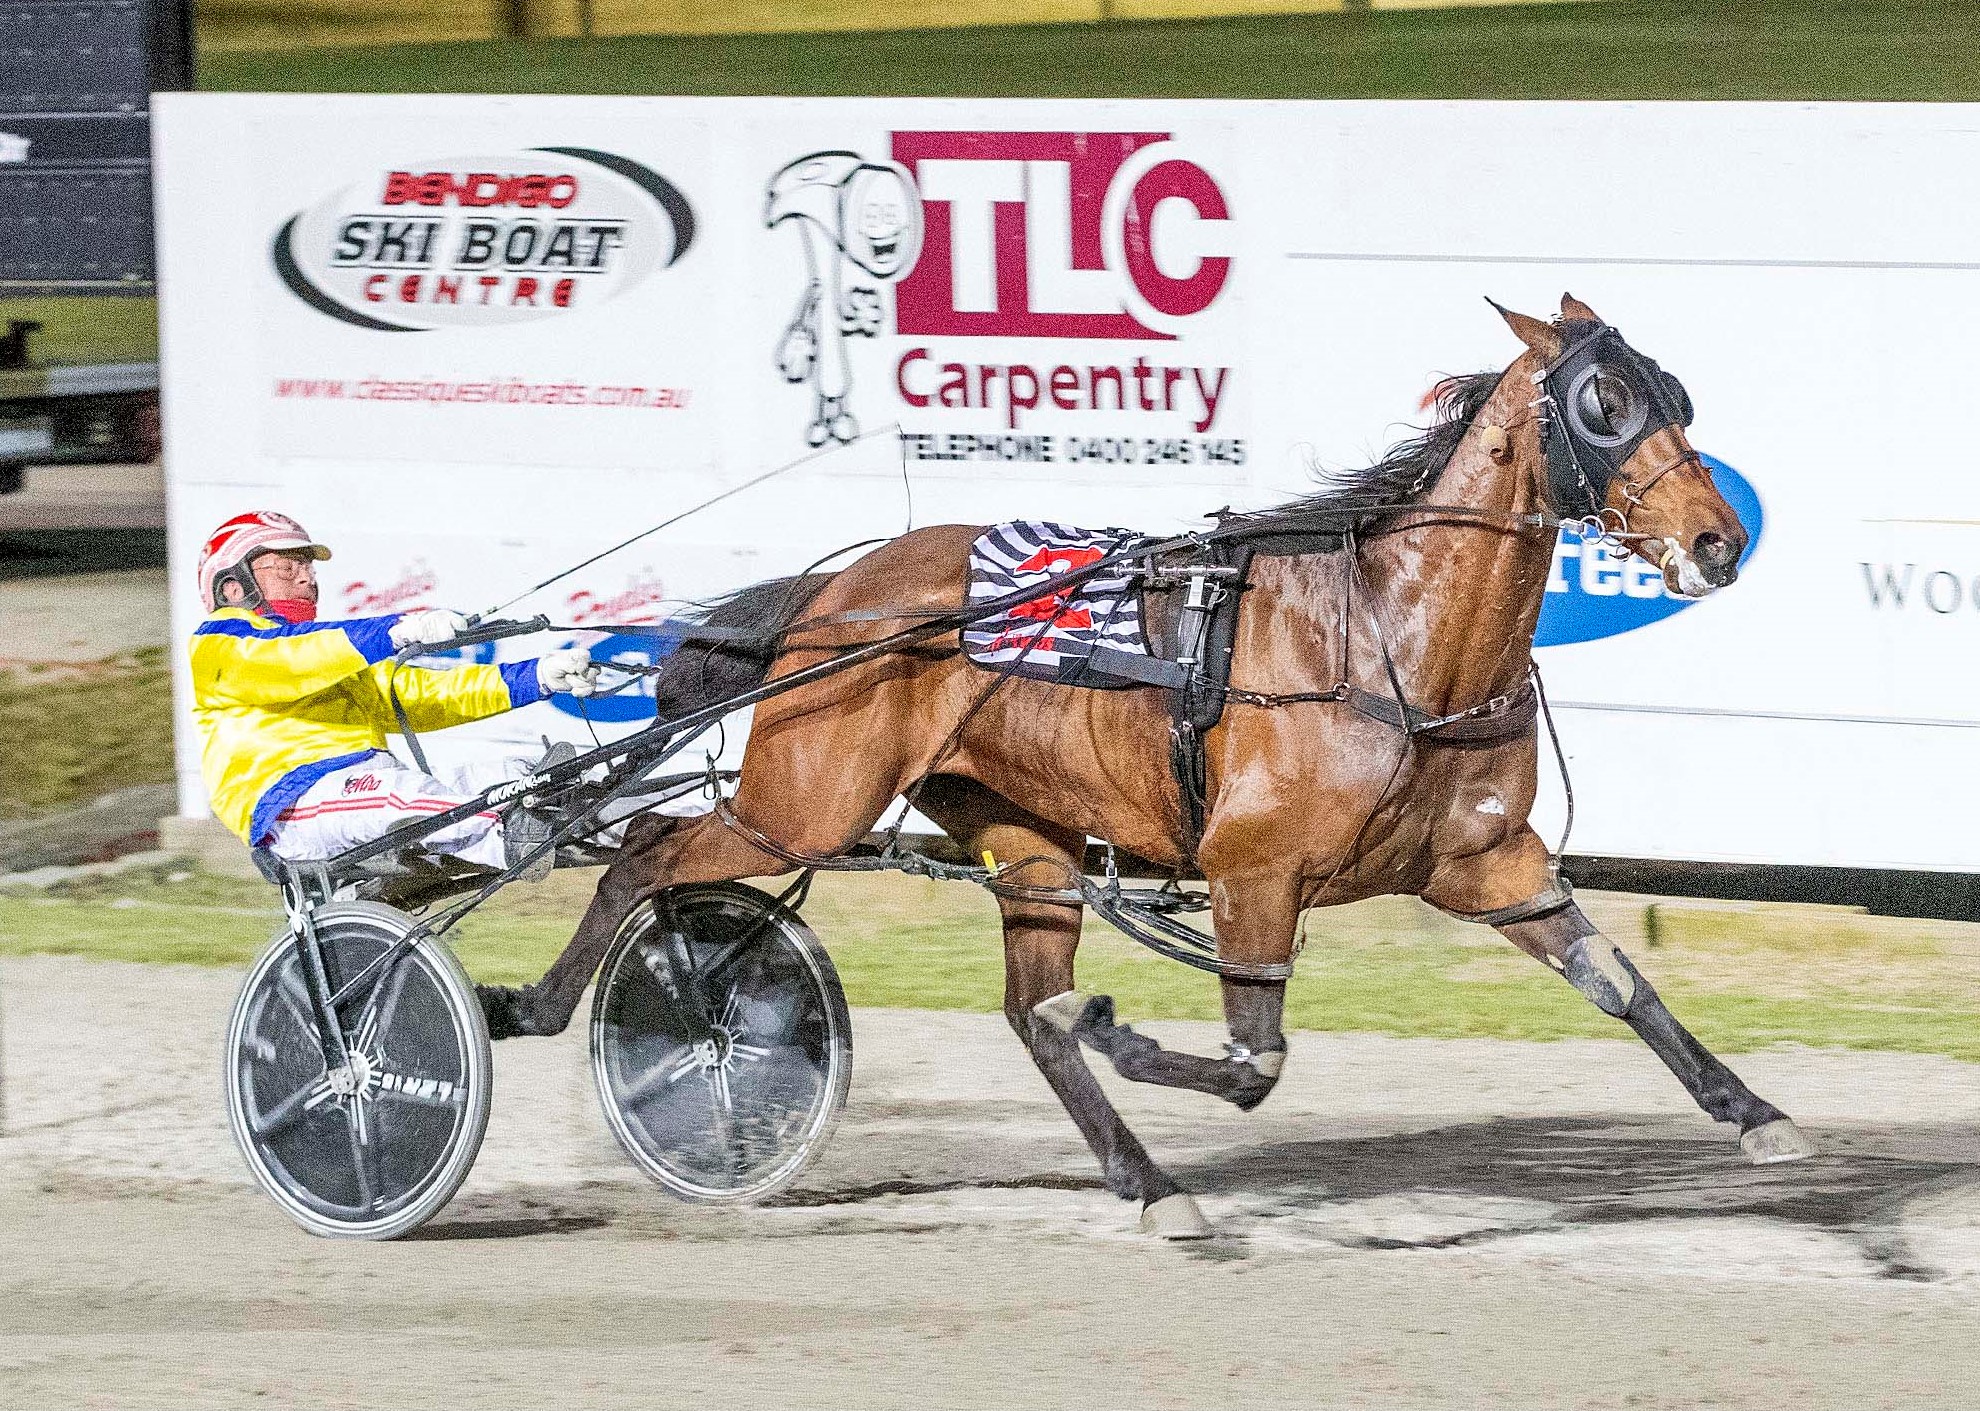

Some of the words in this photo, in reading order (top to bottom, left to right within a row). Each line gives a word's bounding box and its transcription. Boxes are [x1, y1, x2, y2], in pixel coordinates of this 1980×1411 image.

[383, 171, 577, 209] BENDIGO
[334, 220, 441, 264] SKI
[458, 223, 622, 267] BOAT
[914, 157, 1231, 317] TLC
[363, 273, 577, 307] CENTRE
[897, 347, 1228, 433] Carpentry
[899, 433, 1054, 462] TELEPHONE
[1064, 436, 1138, 464] 0400
[1858, 562, 1980, 614] WO
